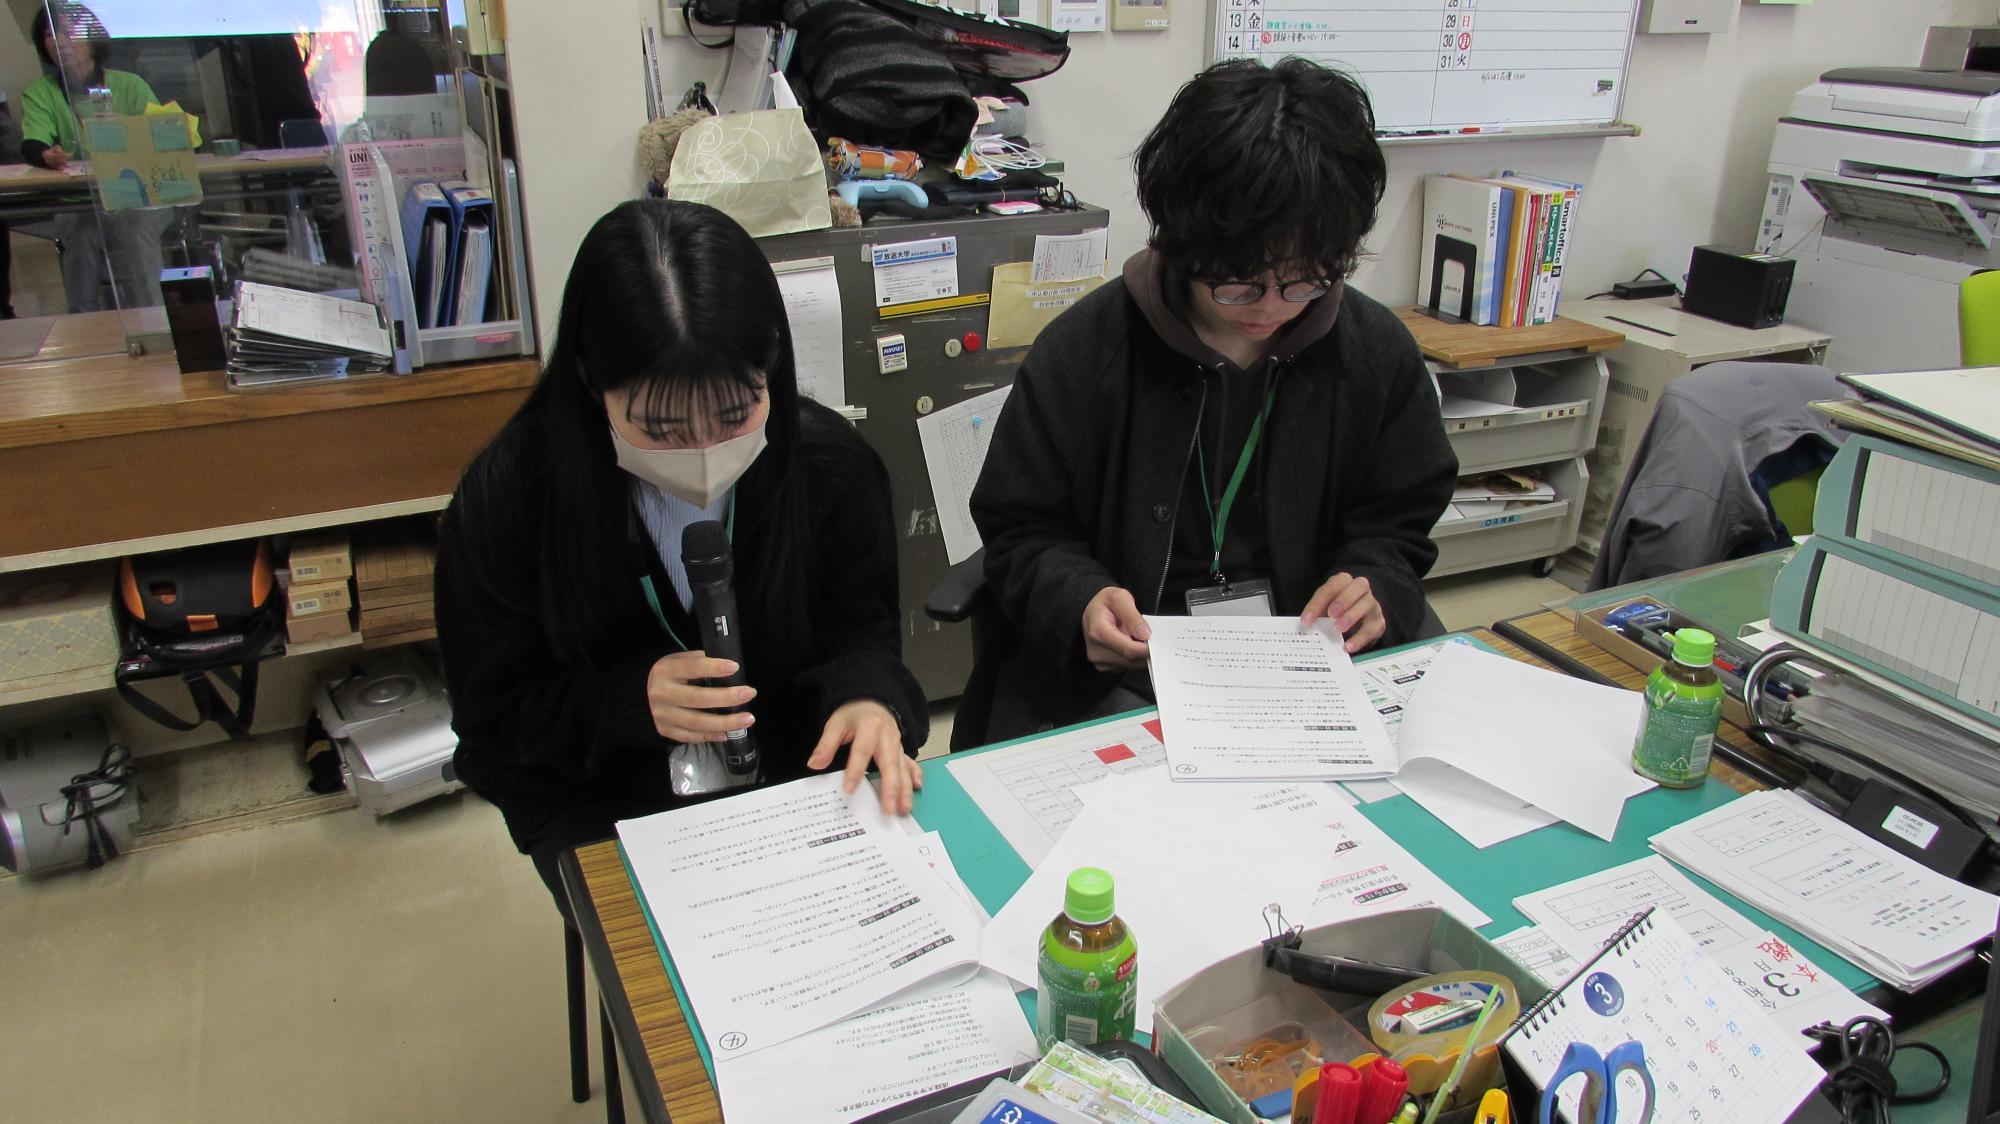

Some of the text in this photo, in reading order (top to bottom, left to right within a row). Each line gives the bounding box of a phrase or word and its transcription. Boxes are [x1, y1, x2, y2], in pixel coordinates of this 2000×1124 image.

[1230, 13, 1241, 28] 13
[1248, 12, 1261, 29] 金
[1446, 14, 1471, 28] 29 日
[1228, 35, 1240, 50] 14
[1246, 34, 1259, 51] 土
[1443, 34, 1470, 49] 30 月
[1440, 54, 1467, 68] 31 火
[349, 153, 368, 164] UNI
[1489, 201, 1497, 238] UNI-PEX
[1554, 200, 1571, 265] smartoffice
[884, 250, 911, 260] 放送大学
[1683, 974, 1693, 986] 7
[1592, 983, 1610, 1002] 3
[1665, 993, 1673, 1004] 6
[1705, 998, 1717, 1009] 14
[1645, 1013, 1655, 1023] 5
[1684, 1015, 1696, 1028] 13
[1726, 1020, 1737, 1034] 21
[1665, 1035, 1677, 1049] 12
[1706, 1039, 1718, 1054] 20
[1531, 1049, 1543, 1063] 2
[1749, 1043, 1762, 1058] 28
[1687, 1059, 1699, 1073] 19
[1729, 1063, 1741, 1079] 27
[1624, 1074, 1637, 1090] 10
[1666, 1079, 1679, 1094] 18
[1708, 1084, 1721, 1100] 26
[1689, 1106, 1702, 1121] 25
